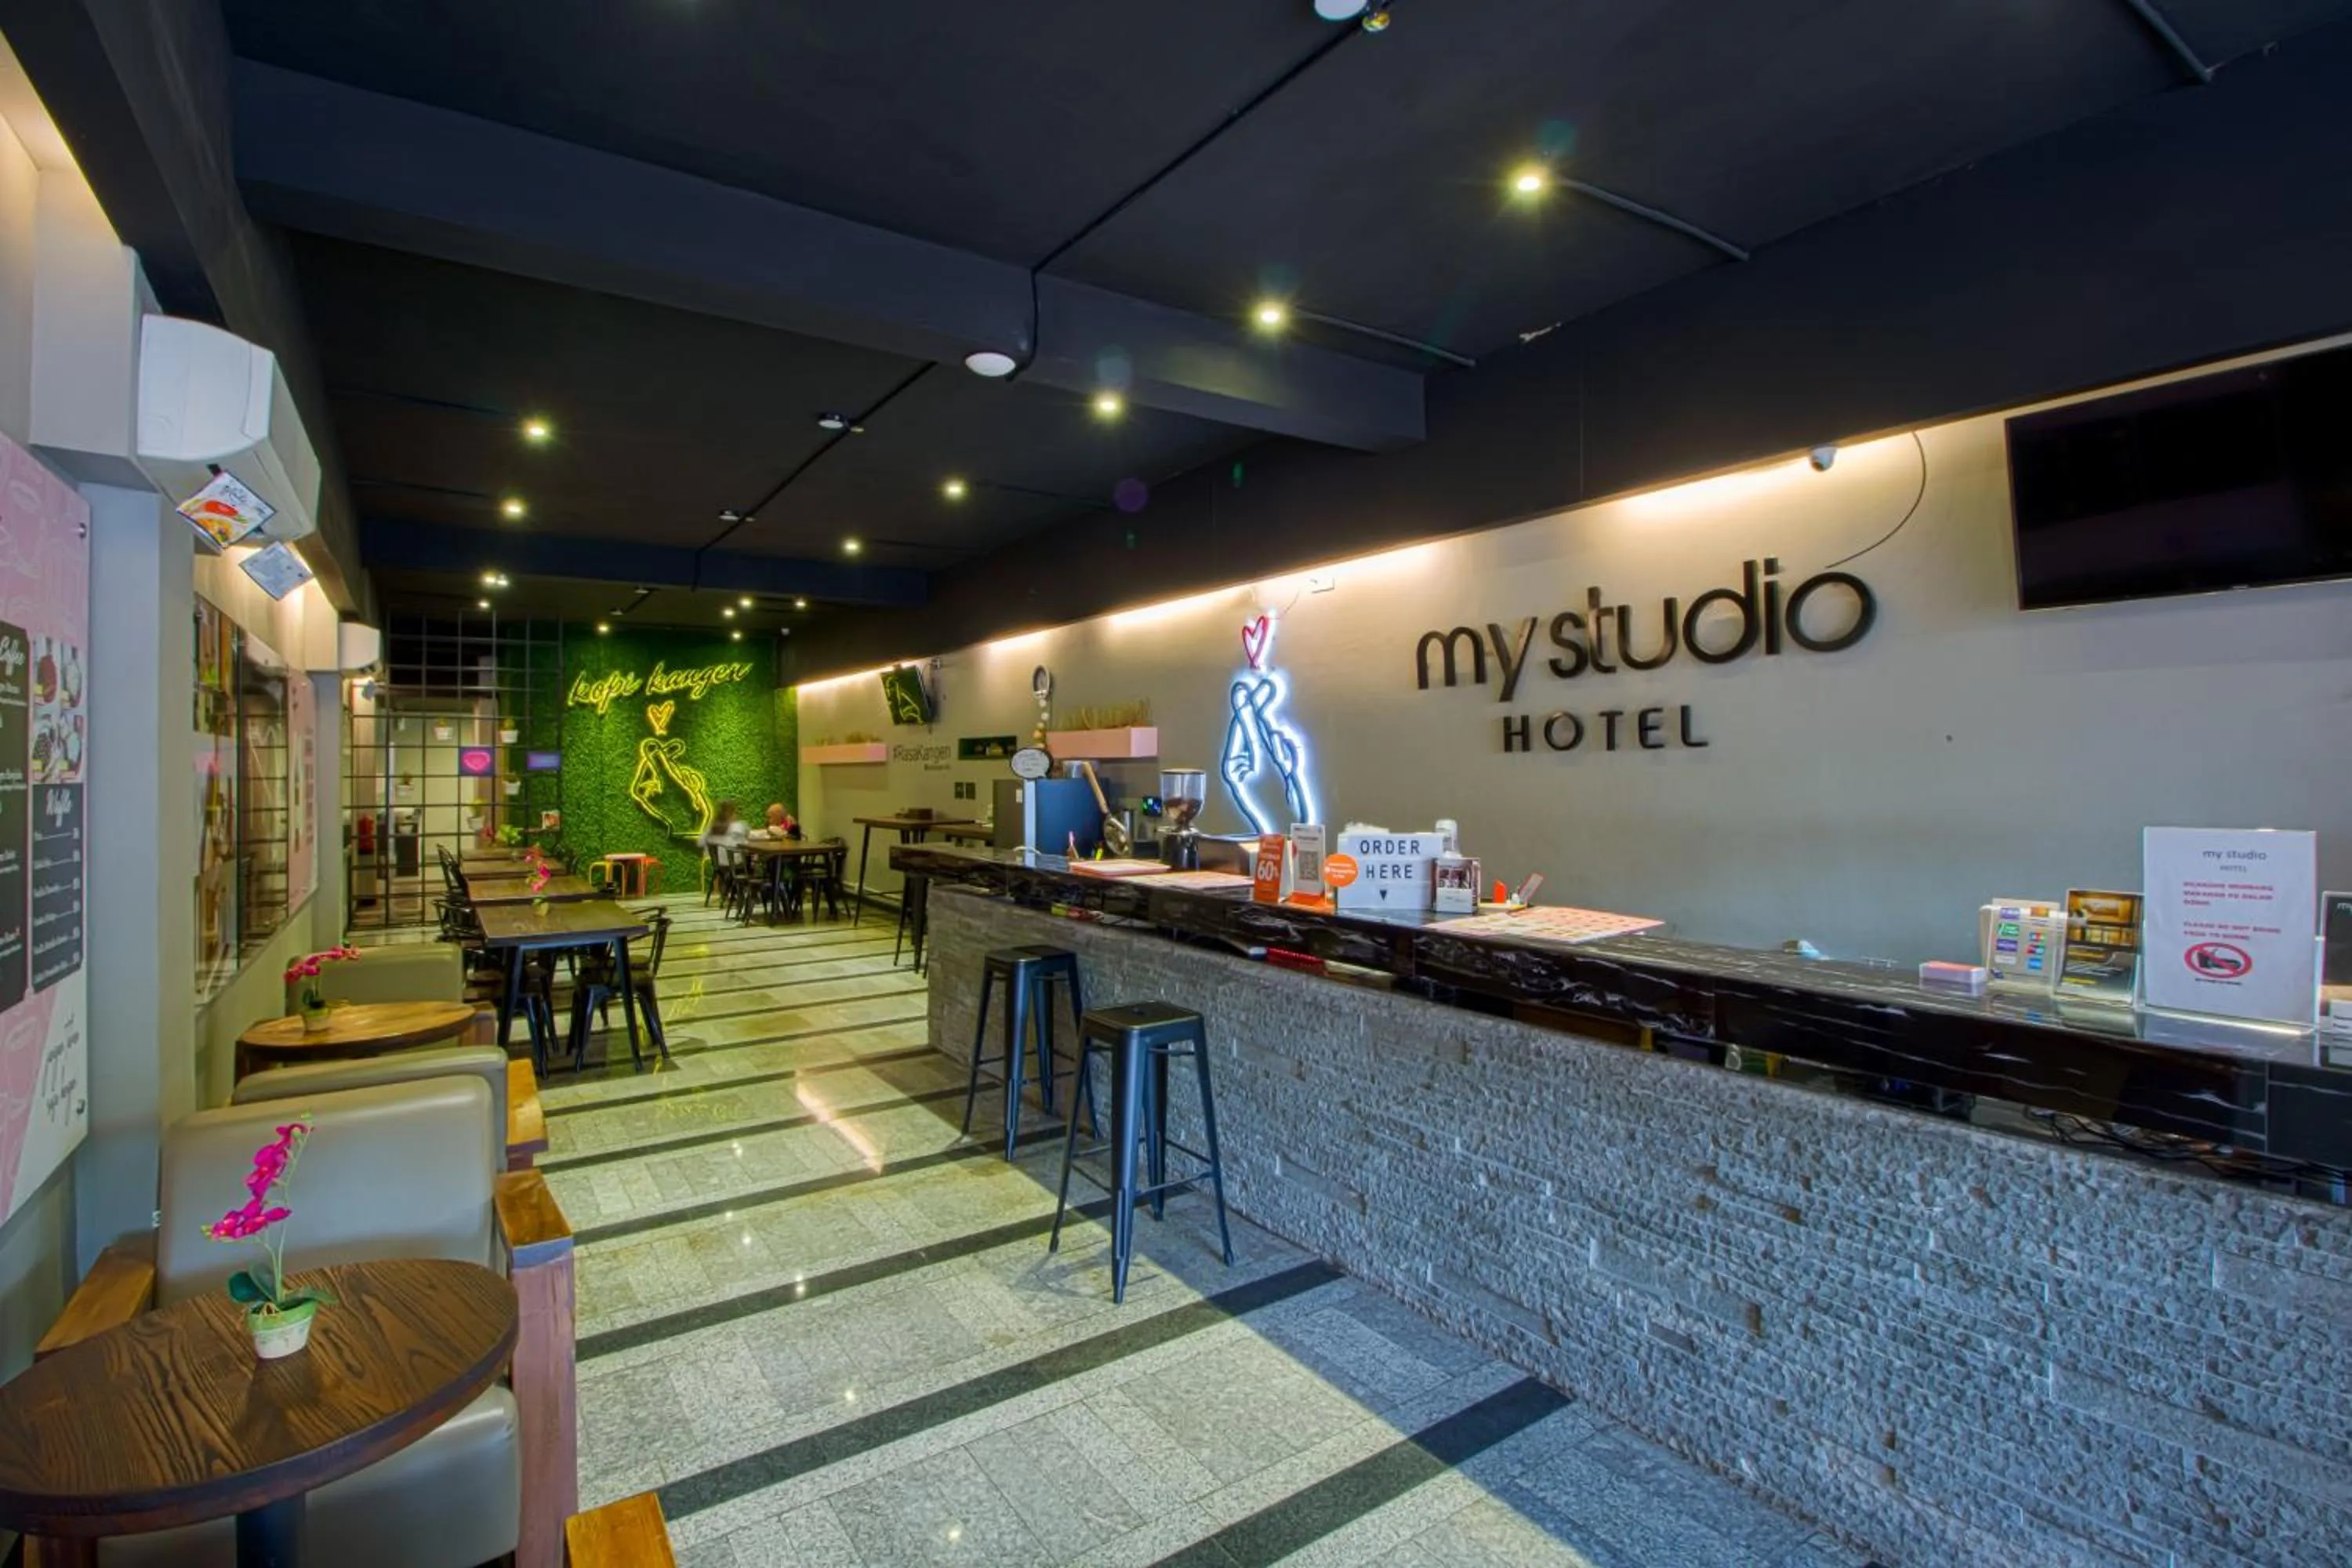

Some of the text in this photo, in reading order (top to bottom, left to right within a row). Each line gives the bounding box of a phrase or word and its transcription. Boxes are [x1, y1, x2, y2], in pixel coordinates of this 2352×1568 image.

[1417, 557, 1877, 702] my studio
[1503, 705, 1709, 753] HOTEL
[1359, 840, 1421, 855] ORDER
[2201, 851, 2268, 861] my studio
[1366, 864, 1414, 879] HERE
